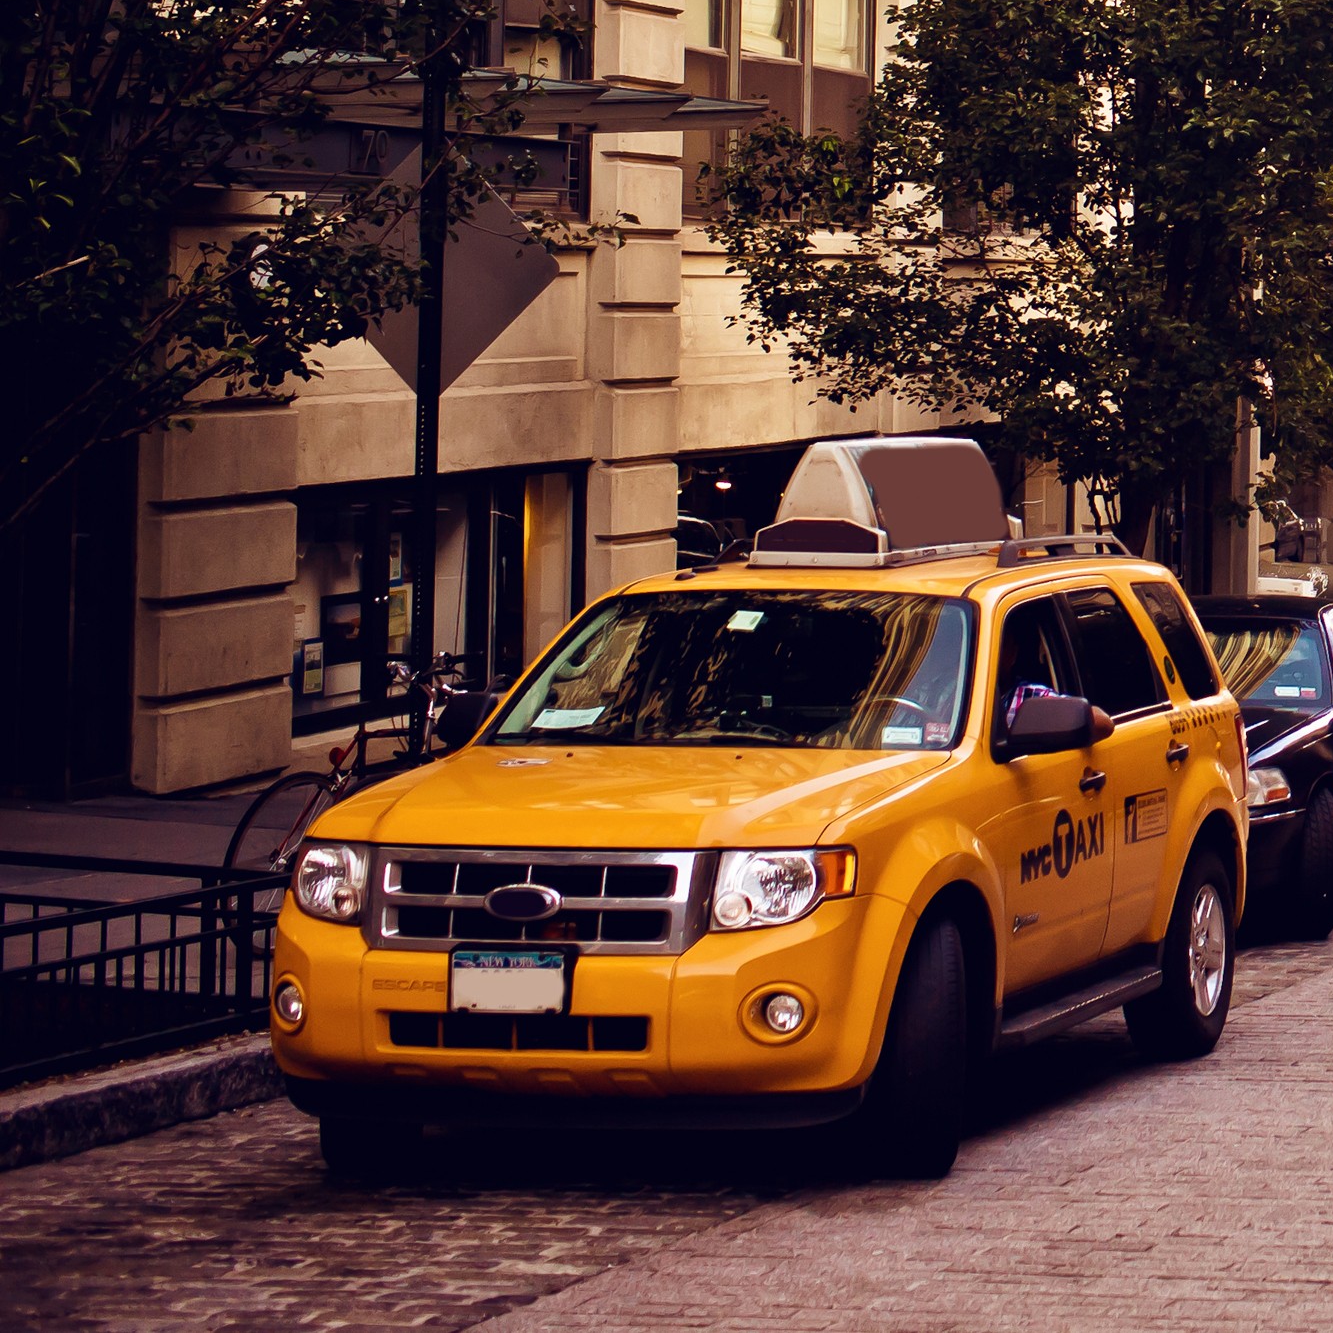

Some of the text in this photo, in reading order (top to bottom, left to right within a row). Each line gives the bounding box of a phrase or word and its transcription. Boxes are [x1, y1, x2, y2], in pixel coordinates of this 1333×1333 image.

[361, 129, 389, 170] 70
[479, 955, 537, 968] NEW YORK
[371, 979, 447, 993] ESCAPE
